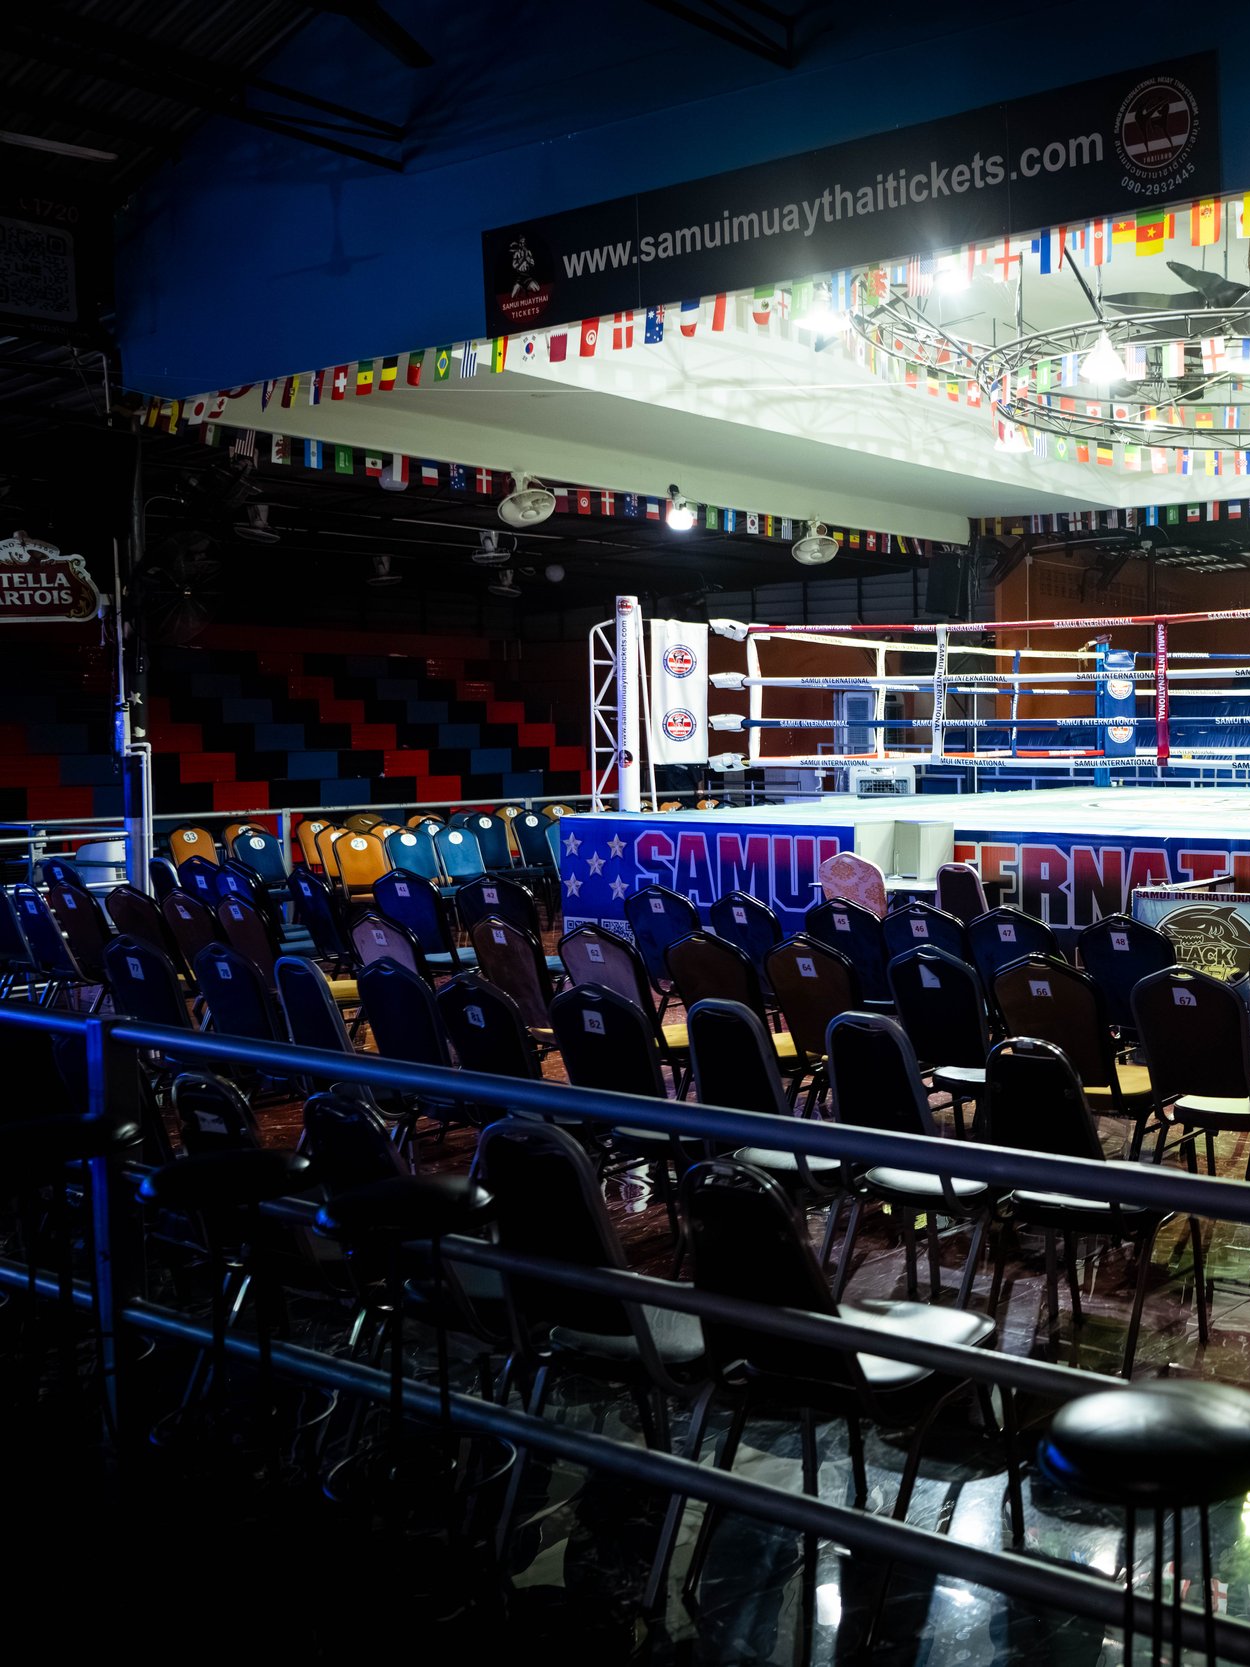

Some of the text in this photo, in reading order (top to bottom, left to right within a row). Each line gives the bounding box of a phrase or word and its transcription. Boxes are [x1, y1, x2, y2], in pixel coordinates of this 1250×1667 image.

[1121, 163, 1196, 196] 090-2932445
[562, 132, 1104, 280] www.samuimuaythaitickets.com
[511, 307, 540, 319] TICKETS
[0, 573, 71, 588] TELLA
[1102, 672, 1156, 680] INTERNATIONA
[185, 833, 197, 842] 33
[353, 839, 366, 849] 21
[1135, 890, 1170, 901] SAMUI
[1115, 938, 1125, 946] 48
[590, 949, 599, 957] 62
[1174, 944, 1237, 967] LACK
[130, 963, 138, 972] 77
[802, 963, 812, 971] 64
[1036, 988, 1048, 996] 66
[1179, 996, 1191, 1005] 67
[588, 1018, 601, 1029] 82
